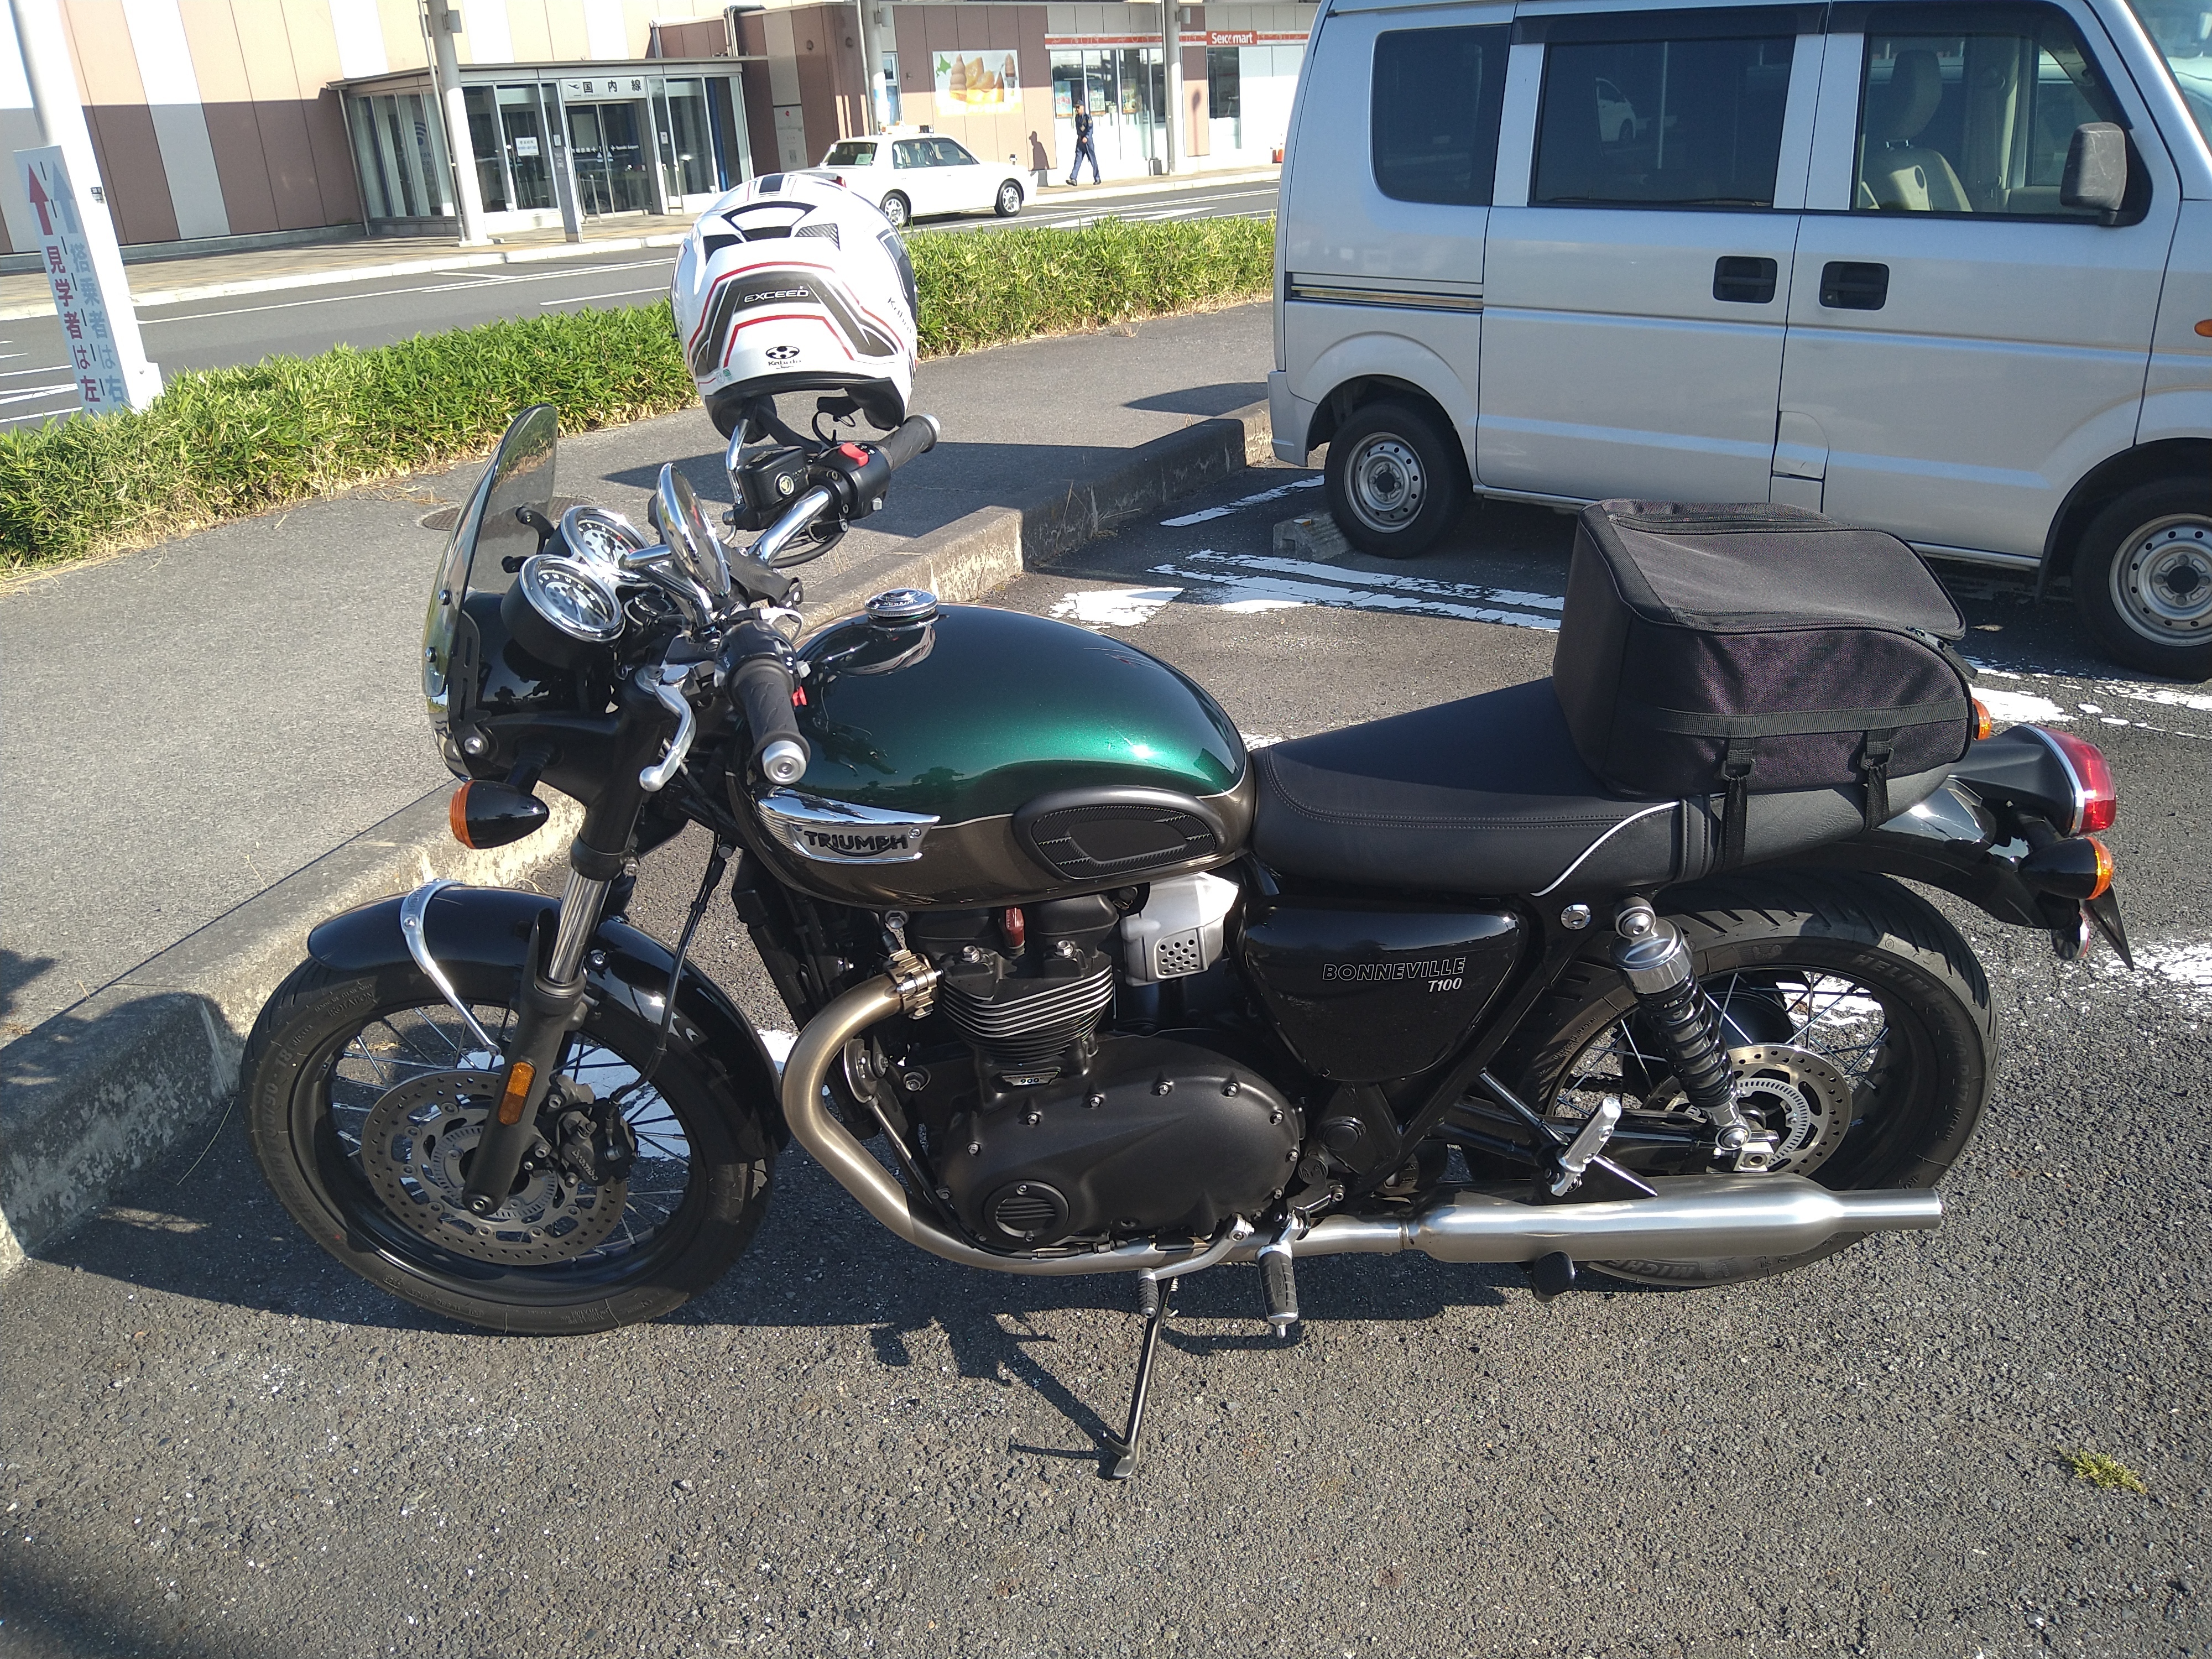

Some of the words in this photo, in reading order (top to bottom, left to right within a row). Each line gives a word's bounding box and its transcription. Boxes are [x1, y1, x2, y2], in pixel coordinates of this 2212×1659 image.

[1211, 32, 1253, 44] Seicomart
[582, 79, 642, 93] 国内線
[744, 289, 809, 303] EXCEED
[46, 246, 101, 415] 見学者は左
[70, 243, 124, 402] 搭乗者は右
[804, 831, 909, 855] TRIUMPH
[1322, 957, 1466, 981] BONNEVILLE
[1850, 954, 1930, 994] HELIN
[1428, 978, 1463, 993] T100
[571, 1149, 598, 1181] brembo
[1605, 1259, 1697, 1280] MICHE
